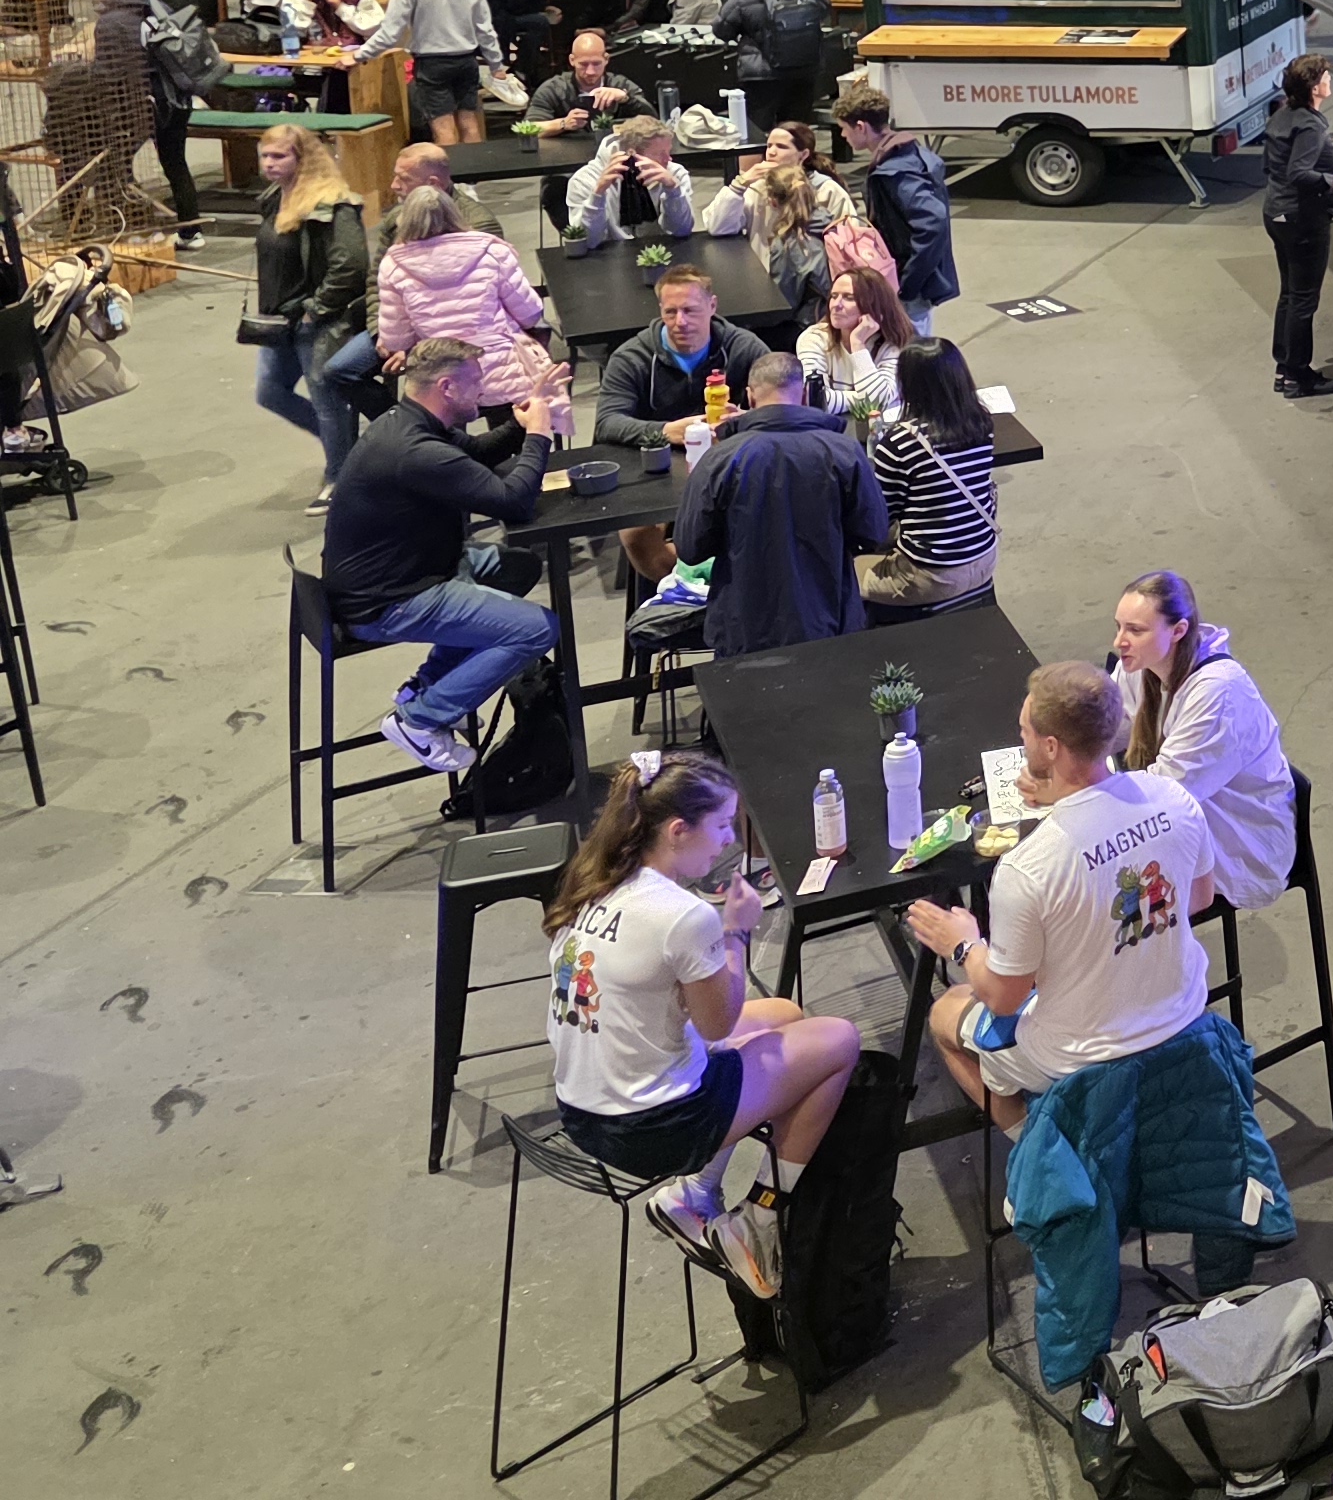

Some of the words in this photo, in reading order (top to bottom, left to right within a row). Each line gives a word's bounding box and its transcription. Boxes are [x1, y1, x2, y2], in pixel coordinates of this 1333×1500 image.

[943, 84, 967, 103] BE
[973, 84, 1024, 103] MORE
[1027, 85, 1139, 104] TULLAMORE
[1082, 811, 1172, 871] MAGNUS
